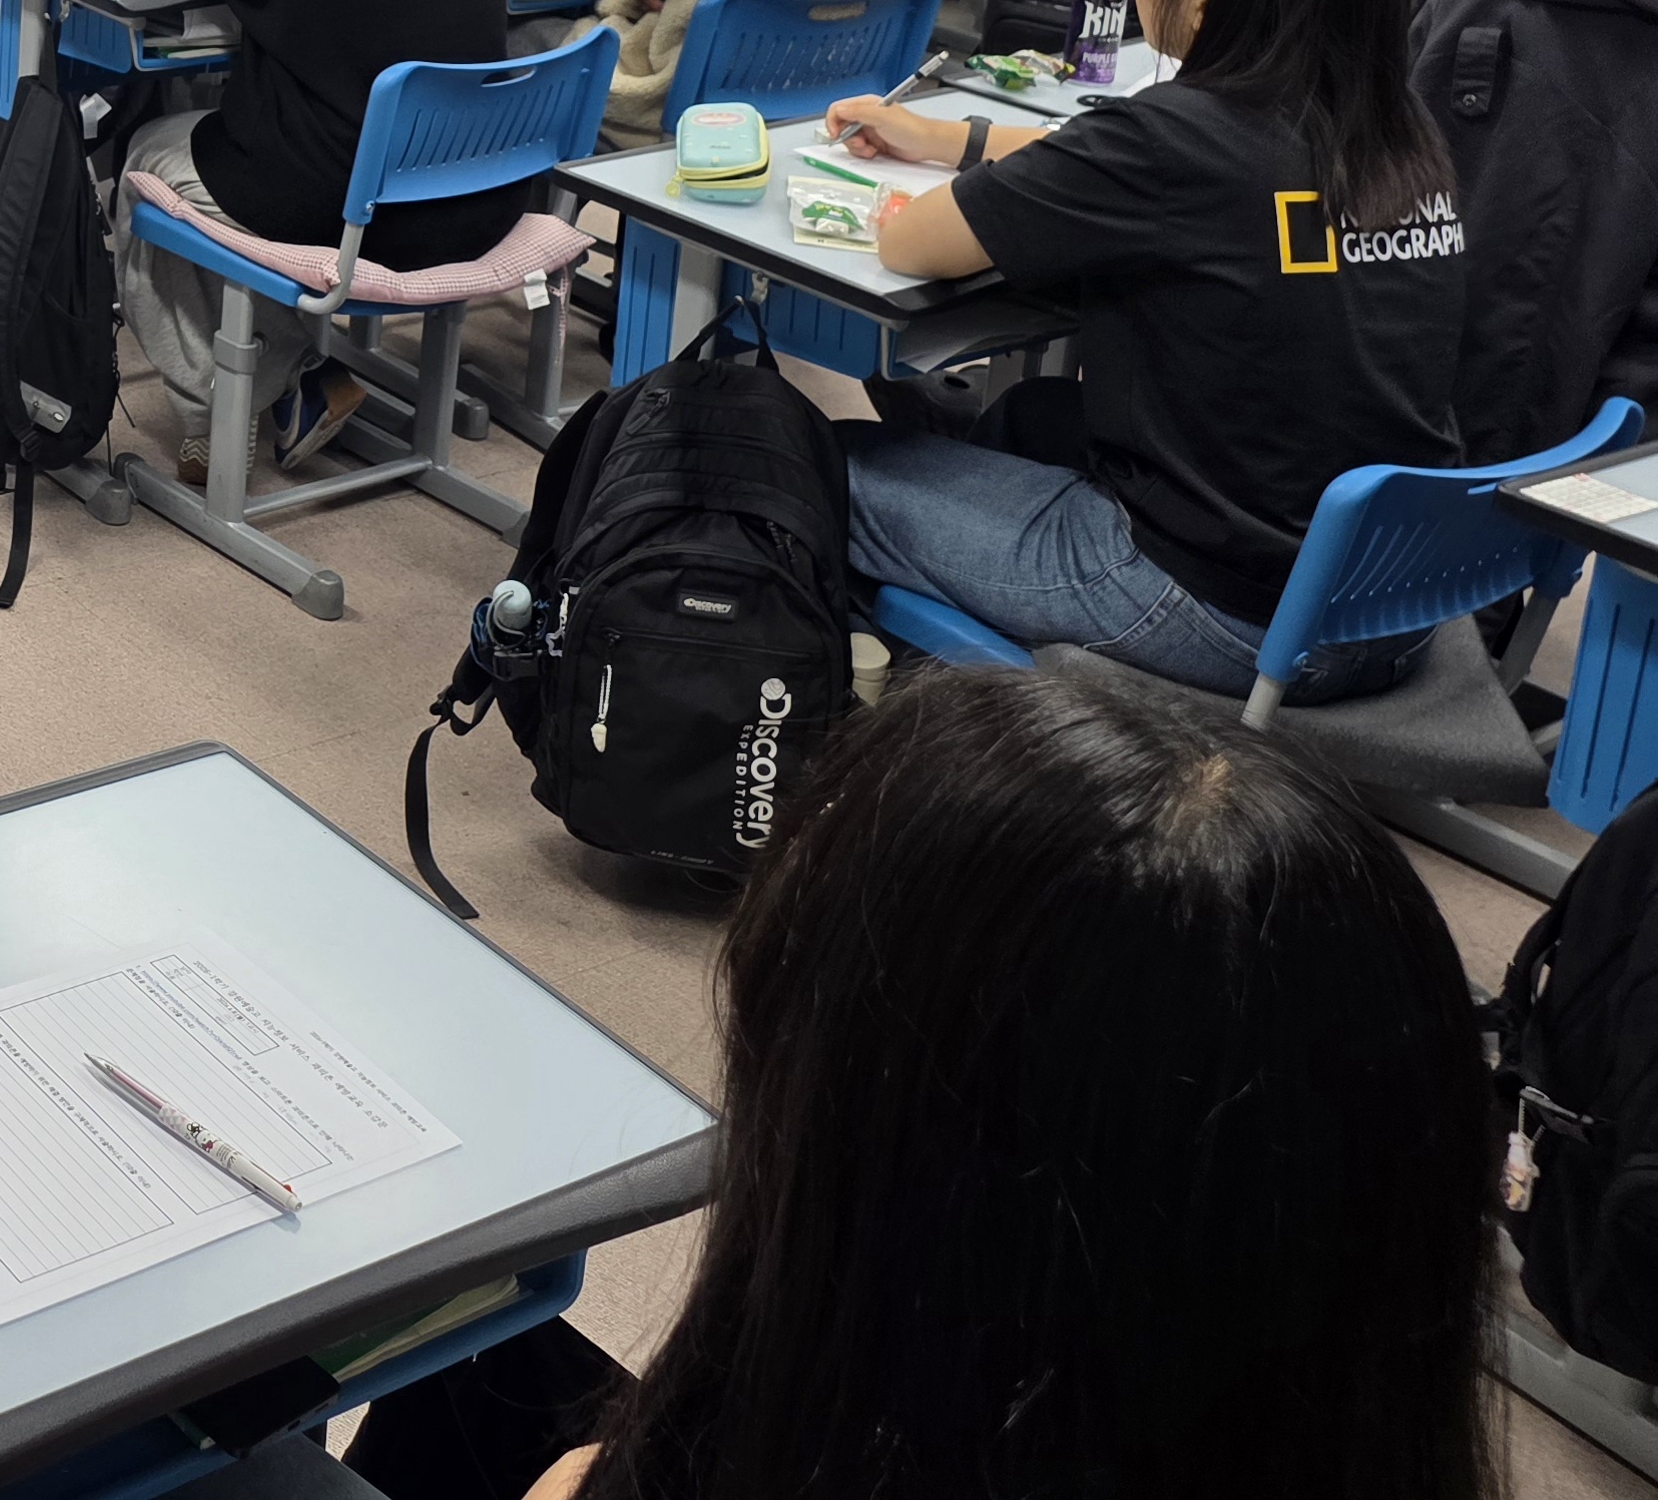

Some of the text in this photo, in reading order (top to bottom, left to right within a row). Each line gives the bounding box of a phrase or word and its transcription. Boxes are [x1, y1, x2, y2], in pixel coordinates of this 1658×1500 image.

[732, 724, 754, 830] EXPEDITION
[261, 1018, 290, 1043] 지능정보
[289, 1043, 310, 1062] 서비스
[311, 1062, 335, 1082] 과의존
[334, 1082, 364, 1108] 예방교육
[363, 1110, 389, 1129] 소감문
